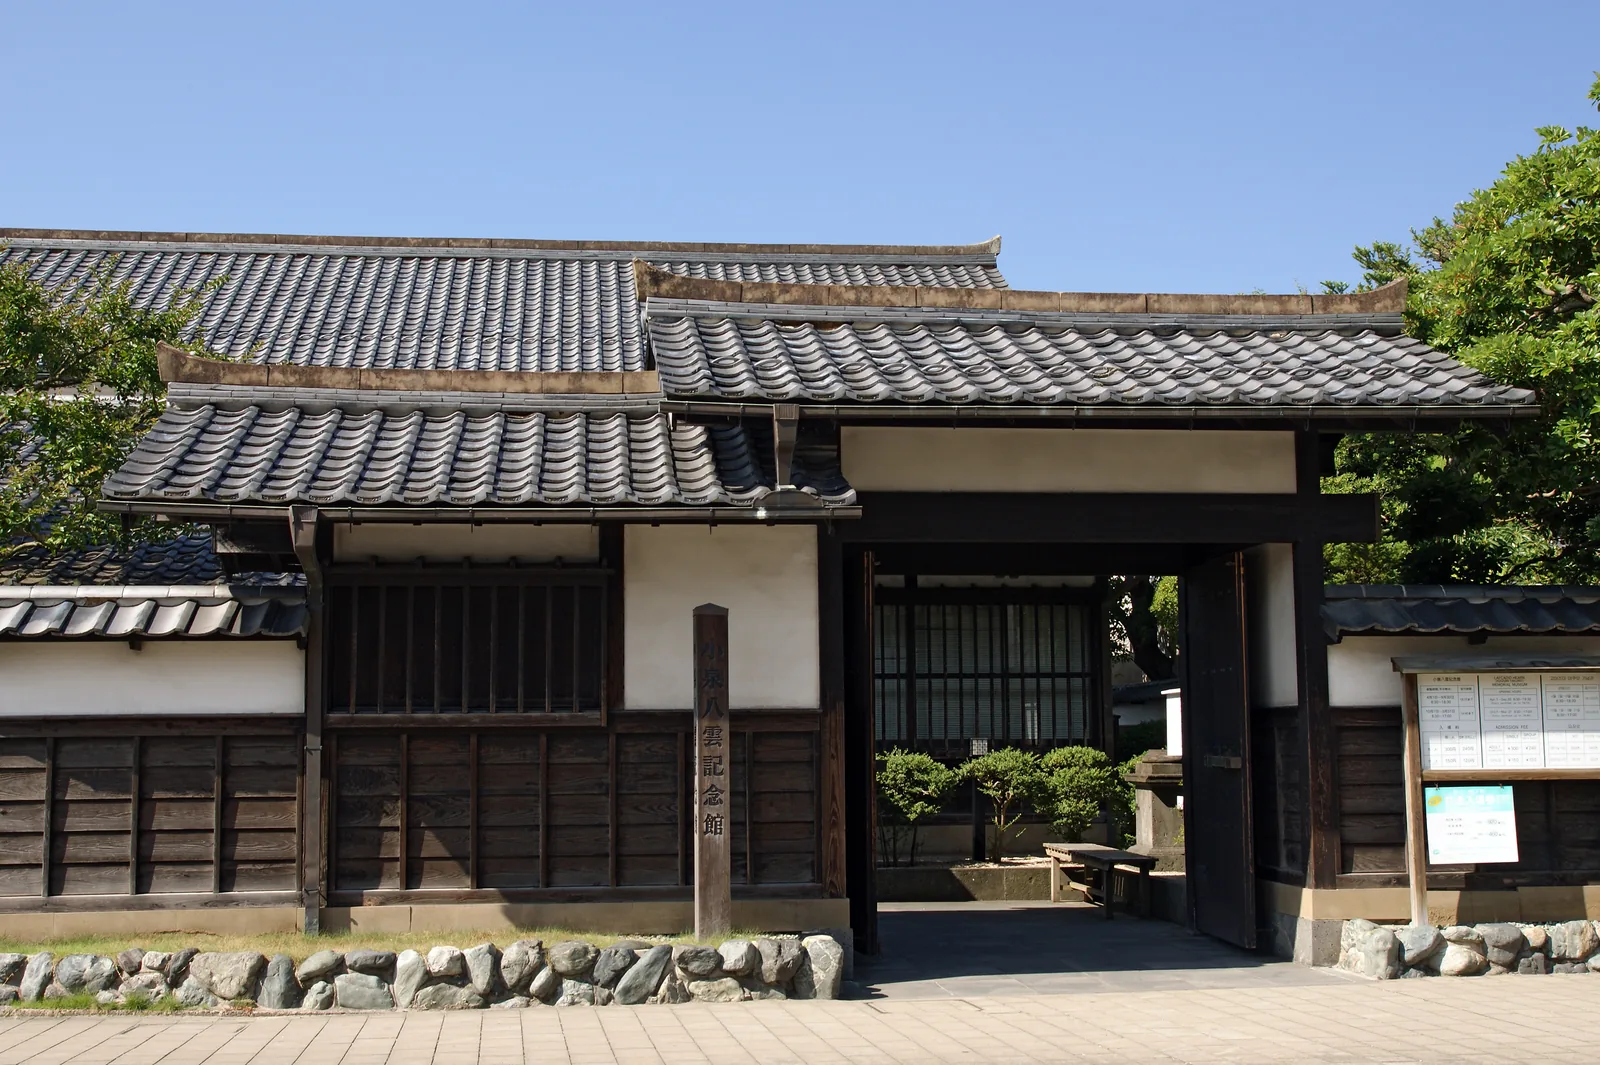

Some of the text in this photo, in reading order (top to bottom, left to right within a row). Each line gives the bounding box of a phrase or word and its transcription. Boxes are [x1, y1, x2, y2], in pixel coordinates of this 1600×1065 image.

[700, 638, 725, 837] 小泉八雲記念館
